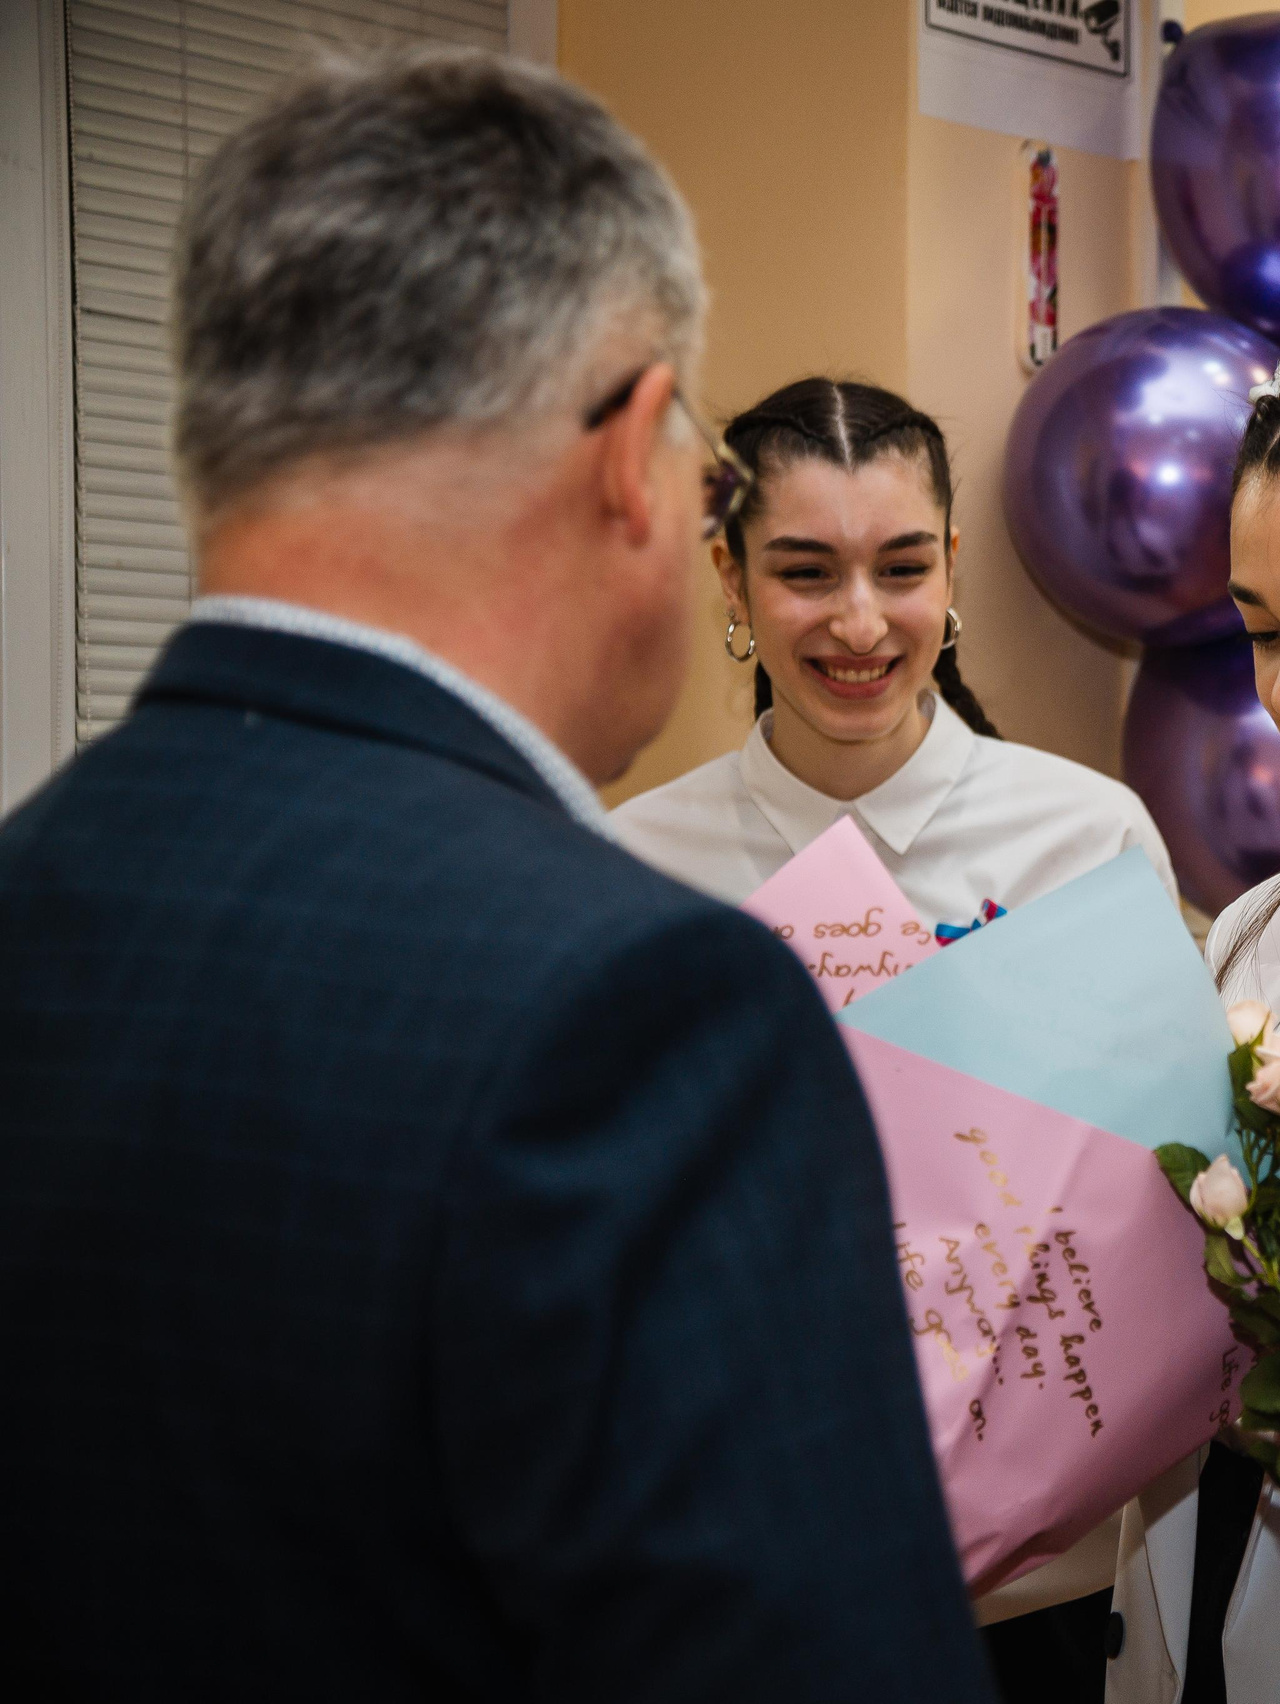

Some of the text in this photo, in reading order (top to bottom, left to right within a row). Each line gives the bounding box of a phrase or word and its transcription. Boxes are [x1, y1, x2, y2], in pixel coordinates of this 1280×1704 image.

[813, 907, 884, 939] goes
[953, 1126, 1104, 1439] good things happen
[974, 1222, 1047, 1390] every day.
[1053, 1230, 1102, 1333] believe
